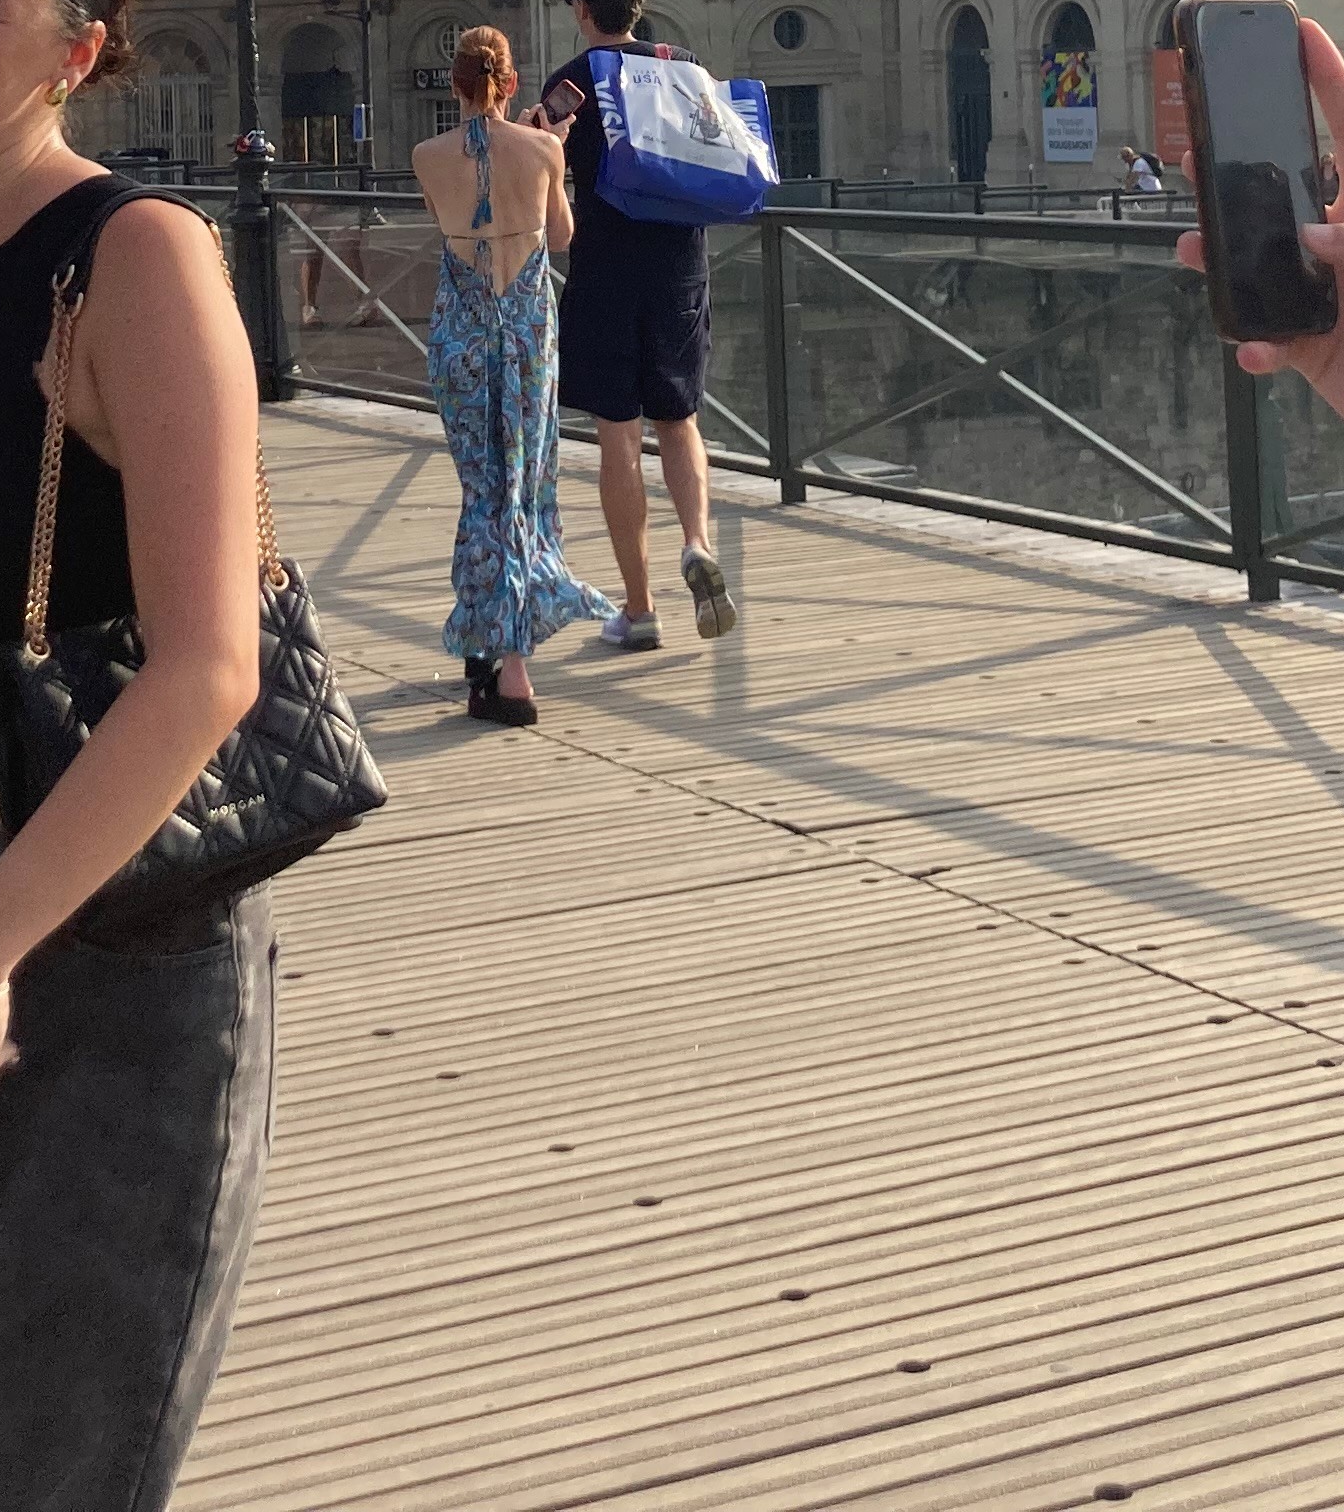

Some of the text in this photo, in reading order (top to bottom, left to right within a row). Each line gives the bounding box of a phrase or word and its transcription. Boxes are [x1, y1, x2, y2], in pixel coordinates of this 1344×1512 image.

[632, 74, 662, 86] USA
[594, 74, 627, 150] VISA
[209, 793, 266, 818] MORGAN
